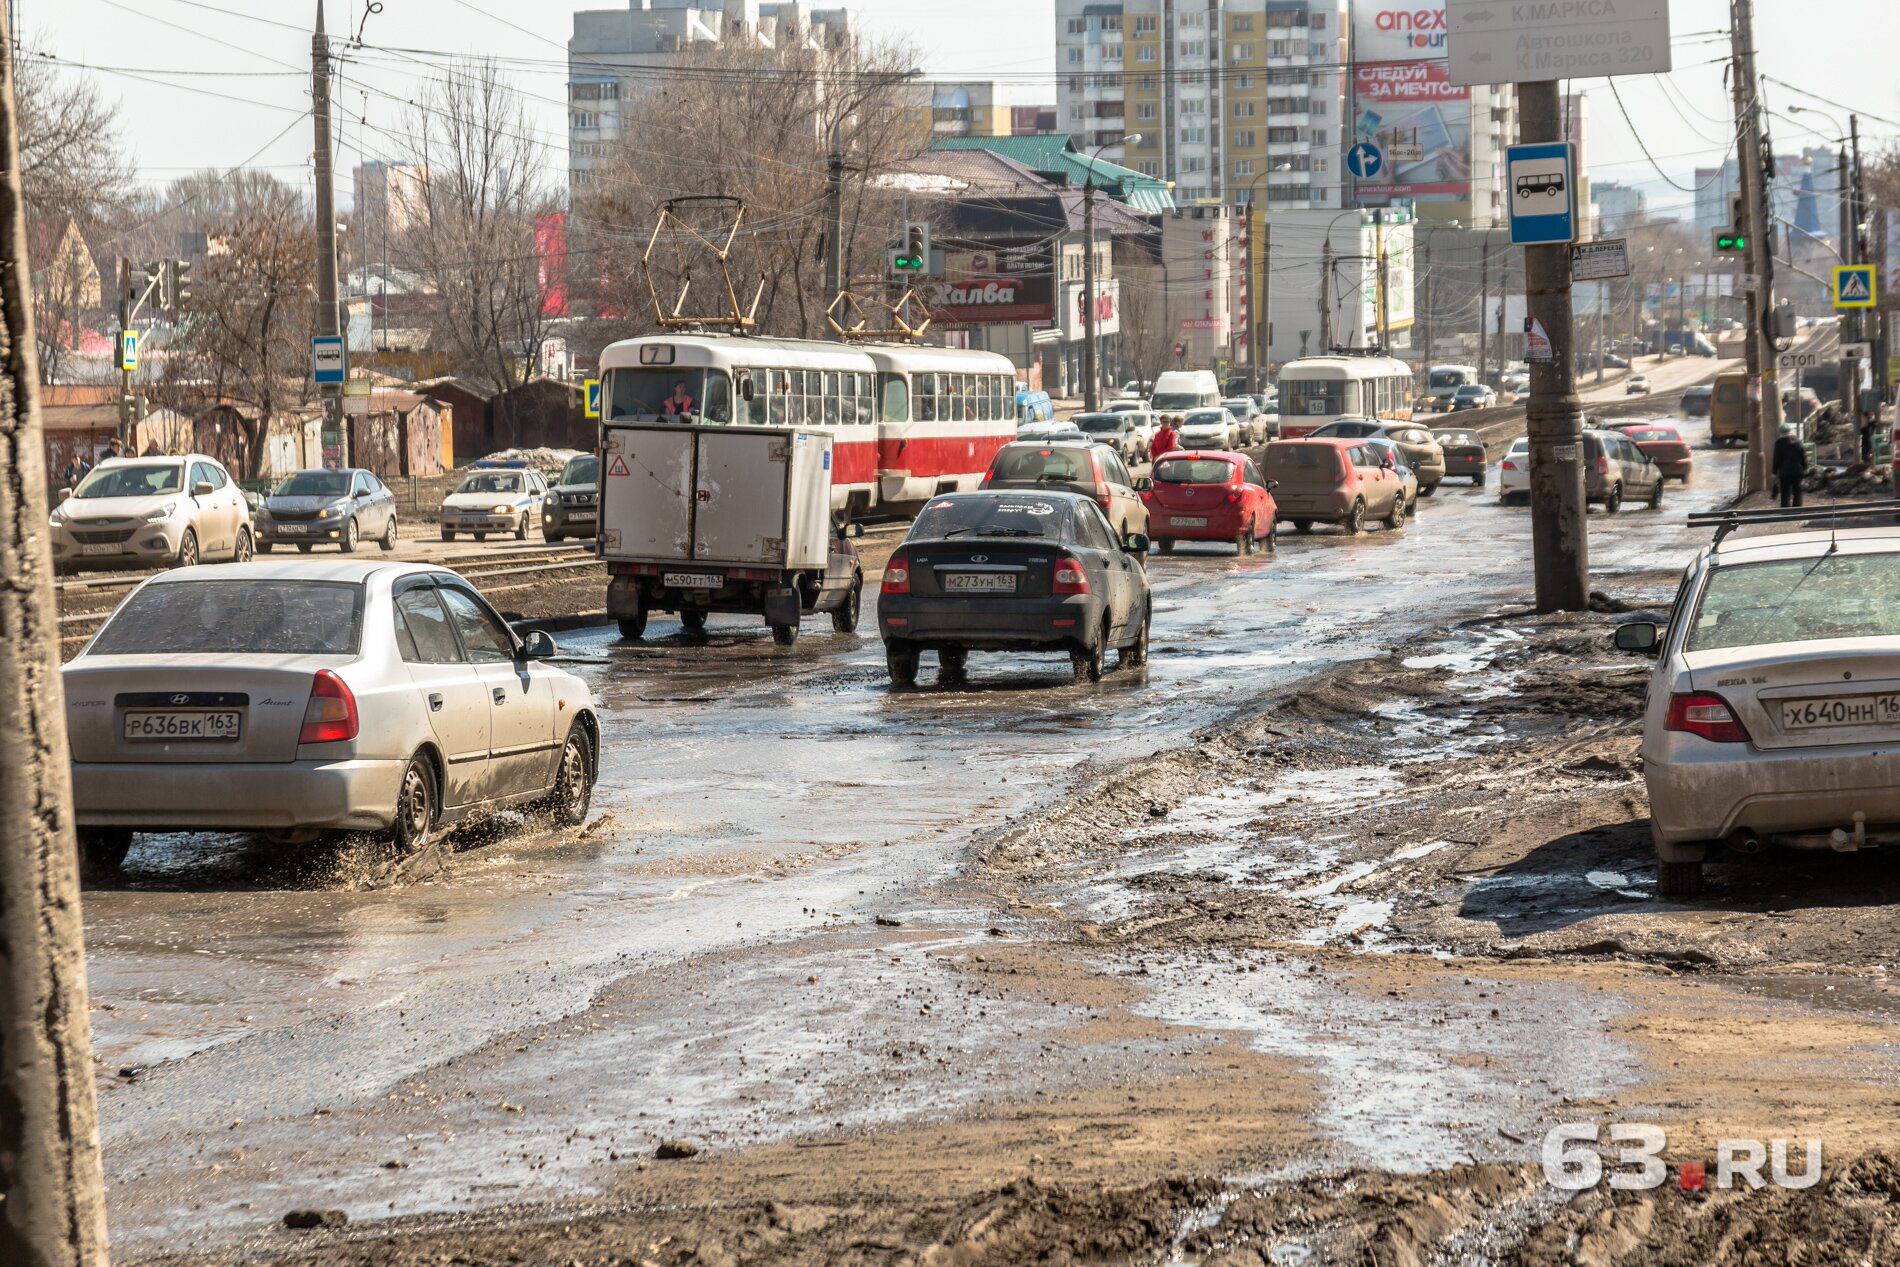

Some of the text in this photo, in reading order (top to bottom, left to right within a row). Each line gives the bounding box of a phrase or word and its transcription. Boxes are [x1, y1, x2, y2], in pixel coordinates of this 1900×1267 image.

[1512, 0, 1617, 22] К.МАРКСА
[1376, 10, 1447, 31] anex
[1407, 33, 1447, 48] tour
[1516, 30, 1633, 50] Автошкола
[1516, 45, 1654, 71] К.Маркса 320
[1360, 64, 1428, 81] СЛЕДУЙ
[1370, 83, 1391, 96] ЗА
[1202, 229, 1214, 320] HOTEL
[650, 347, 659, 363] 7
[1781, 354, 1816, 366] СТОП
[1312, 402, 1323, 411] 19
[706, 575, 720, 583] 163
[948, 576, 1013, 588] М273УН 163
[1717, 678, 1747, 687] NEXIA
[1790, 702, 1874, 725] Х640НН
[131, 716, 202, 734] Р636ВК
[207, 715, 234, 729] 163
